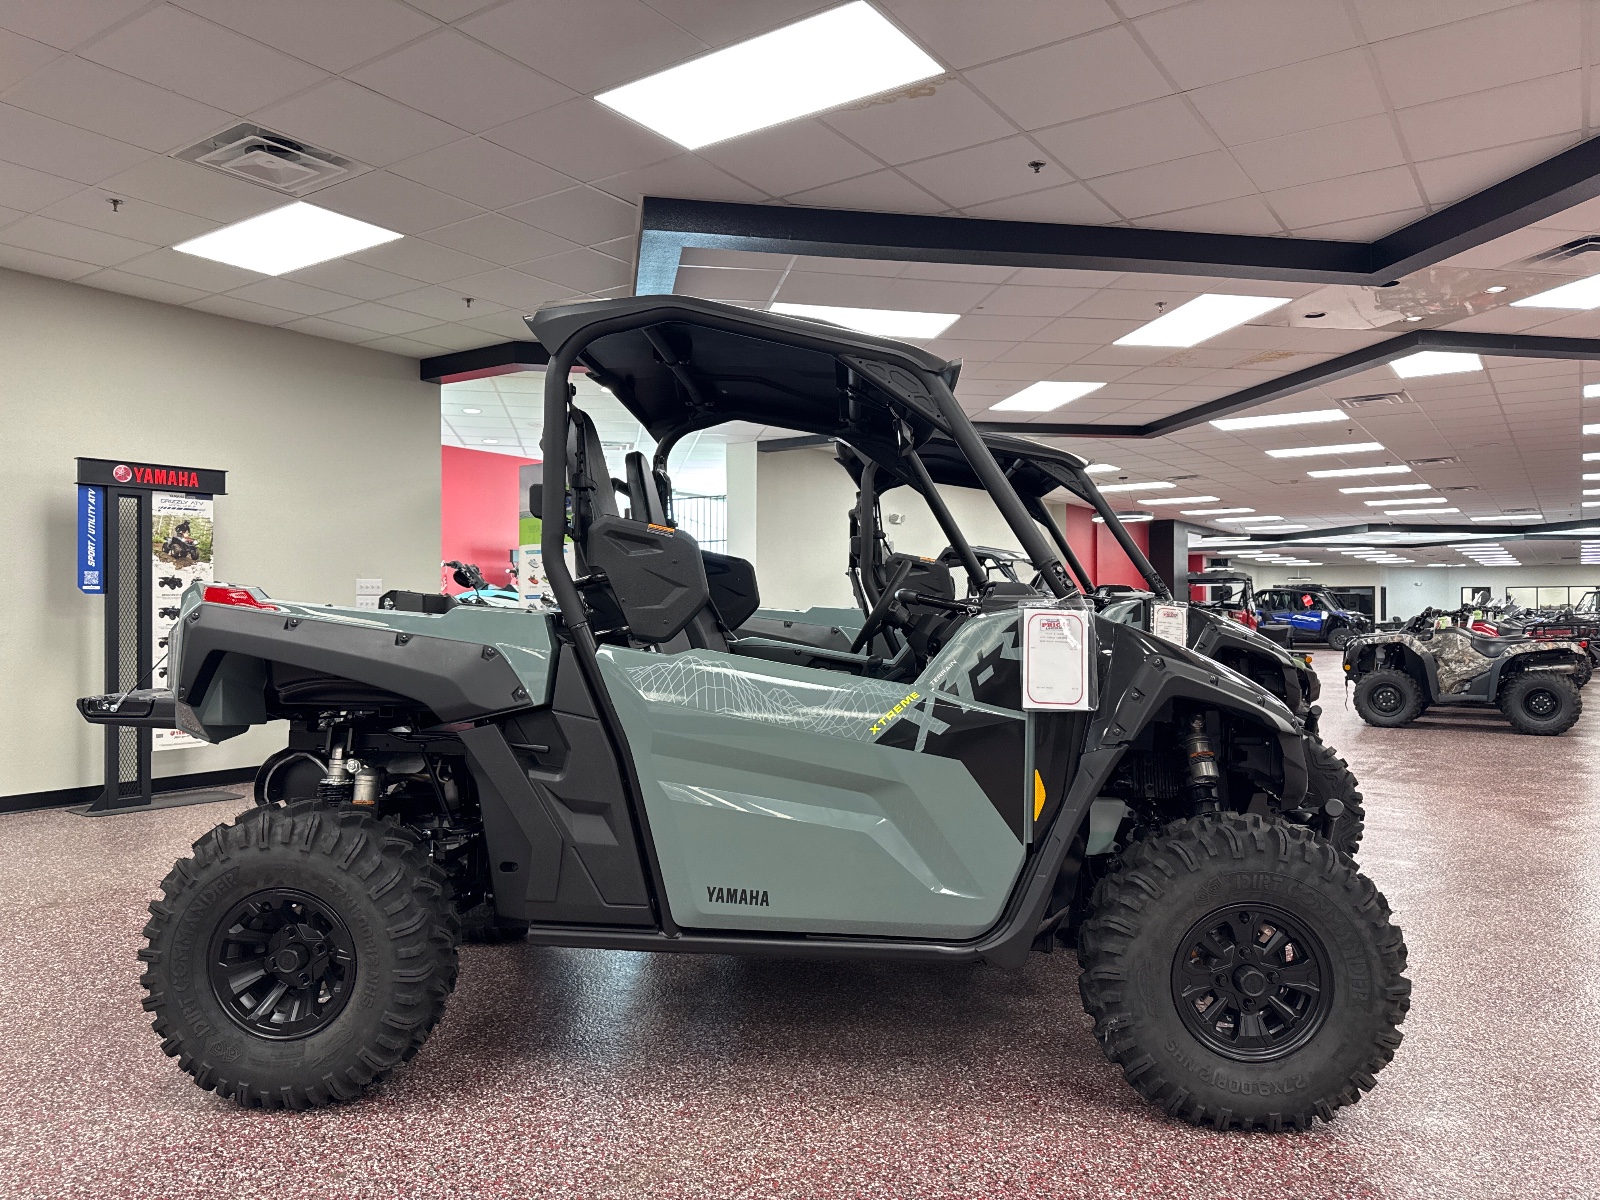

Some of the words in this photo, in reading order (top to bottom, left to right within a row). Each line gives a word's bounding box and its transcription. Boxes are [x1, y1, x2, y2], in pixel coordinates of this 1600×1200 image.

[133, 467, 199, 487] YAMAHA
[88, 488, 96, 505] ATV
[88, 504, 96, 534] UTILITY
[88, 540, 96, 567] SPORT
[928, 659, 958, 686] TERRAIN
[869, 691, 921, 735] XTREME
[1236, 874, 1284, 891] DIRT
[706, 886, 769, 907] YAMAHA
